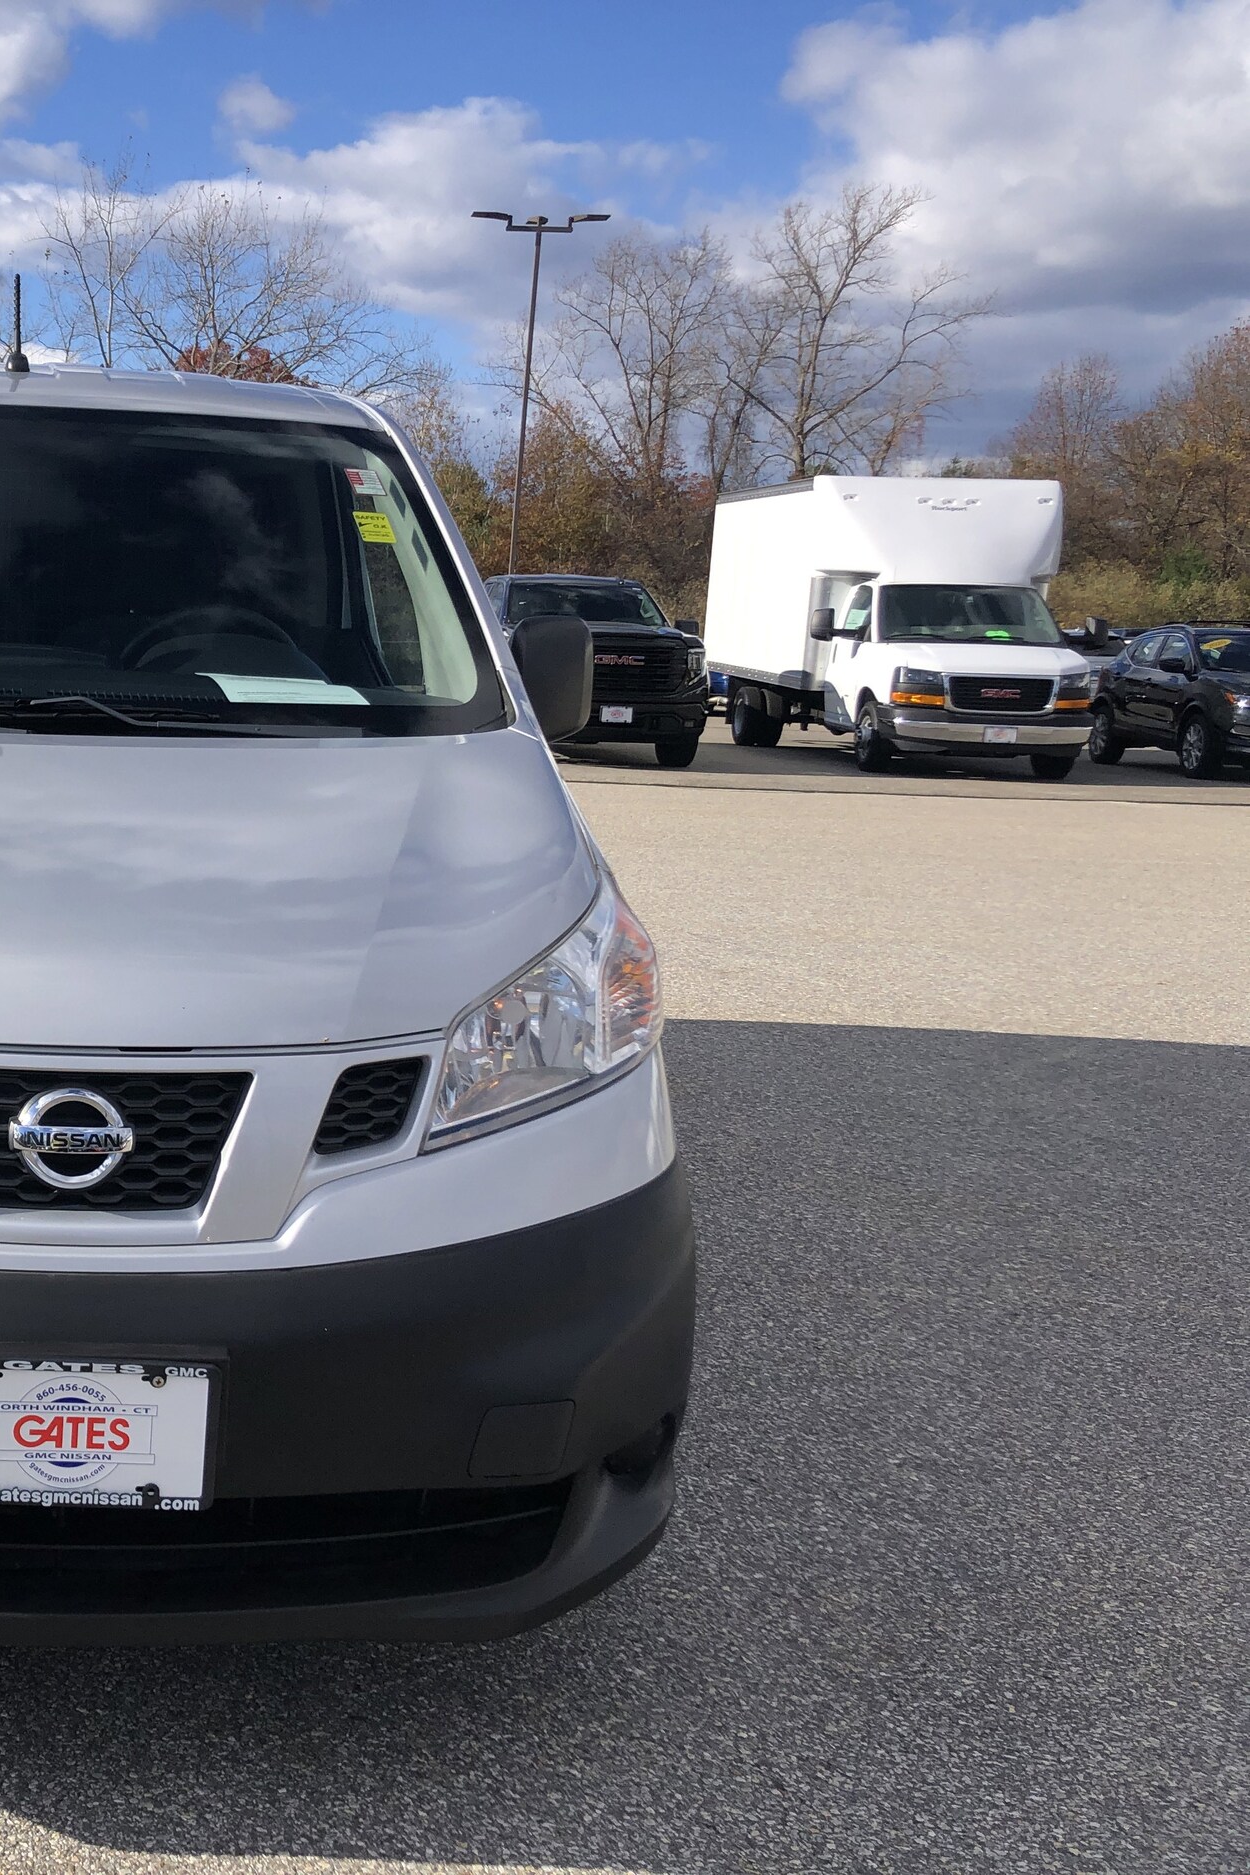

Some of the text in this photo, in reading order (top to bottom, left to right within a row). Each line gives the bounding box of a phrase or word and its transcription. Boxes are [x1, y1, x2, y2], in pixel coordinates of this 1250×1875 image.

[595, 655, 645, 665] GMC
[981, 688, 1021, 698] GMC
[25, 1131, 120, 1148] NISSAN
[3, 1360, 145, 1374] GATES
[164, 1367, 208, 1378] GMC
[36, 1383, 106, 1402] 860-456-0055
[42, 1404, 115, 1413] WINDHAM
[13, 1415, 130, 1450] GATES
[28, 1462, 106, 1483] gatesgmcnissan.com
